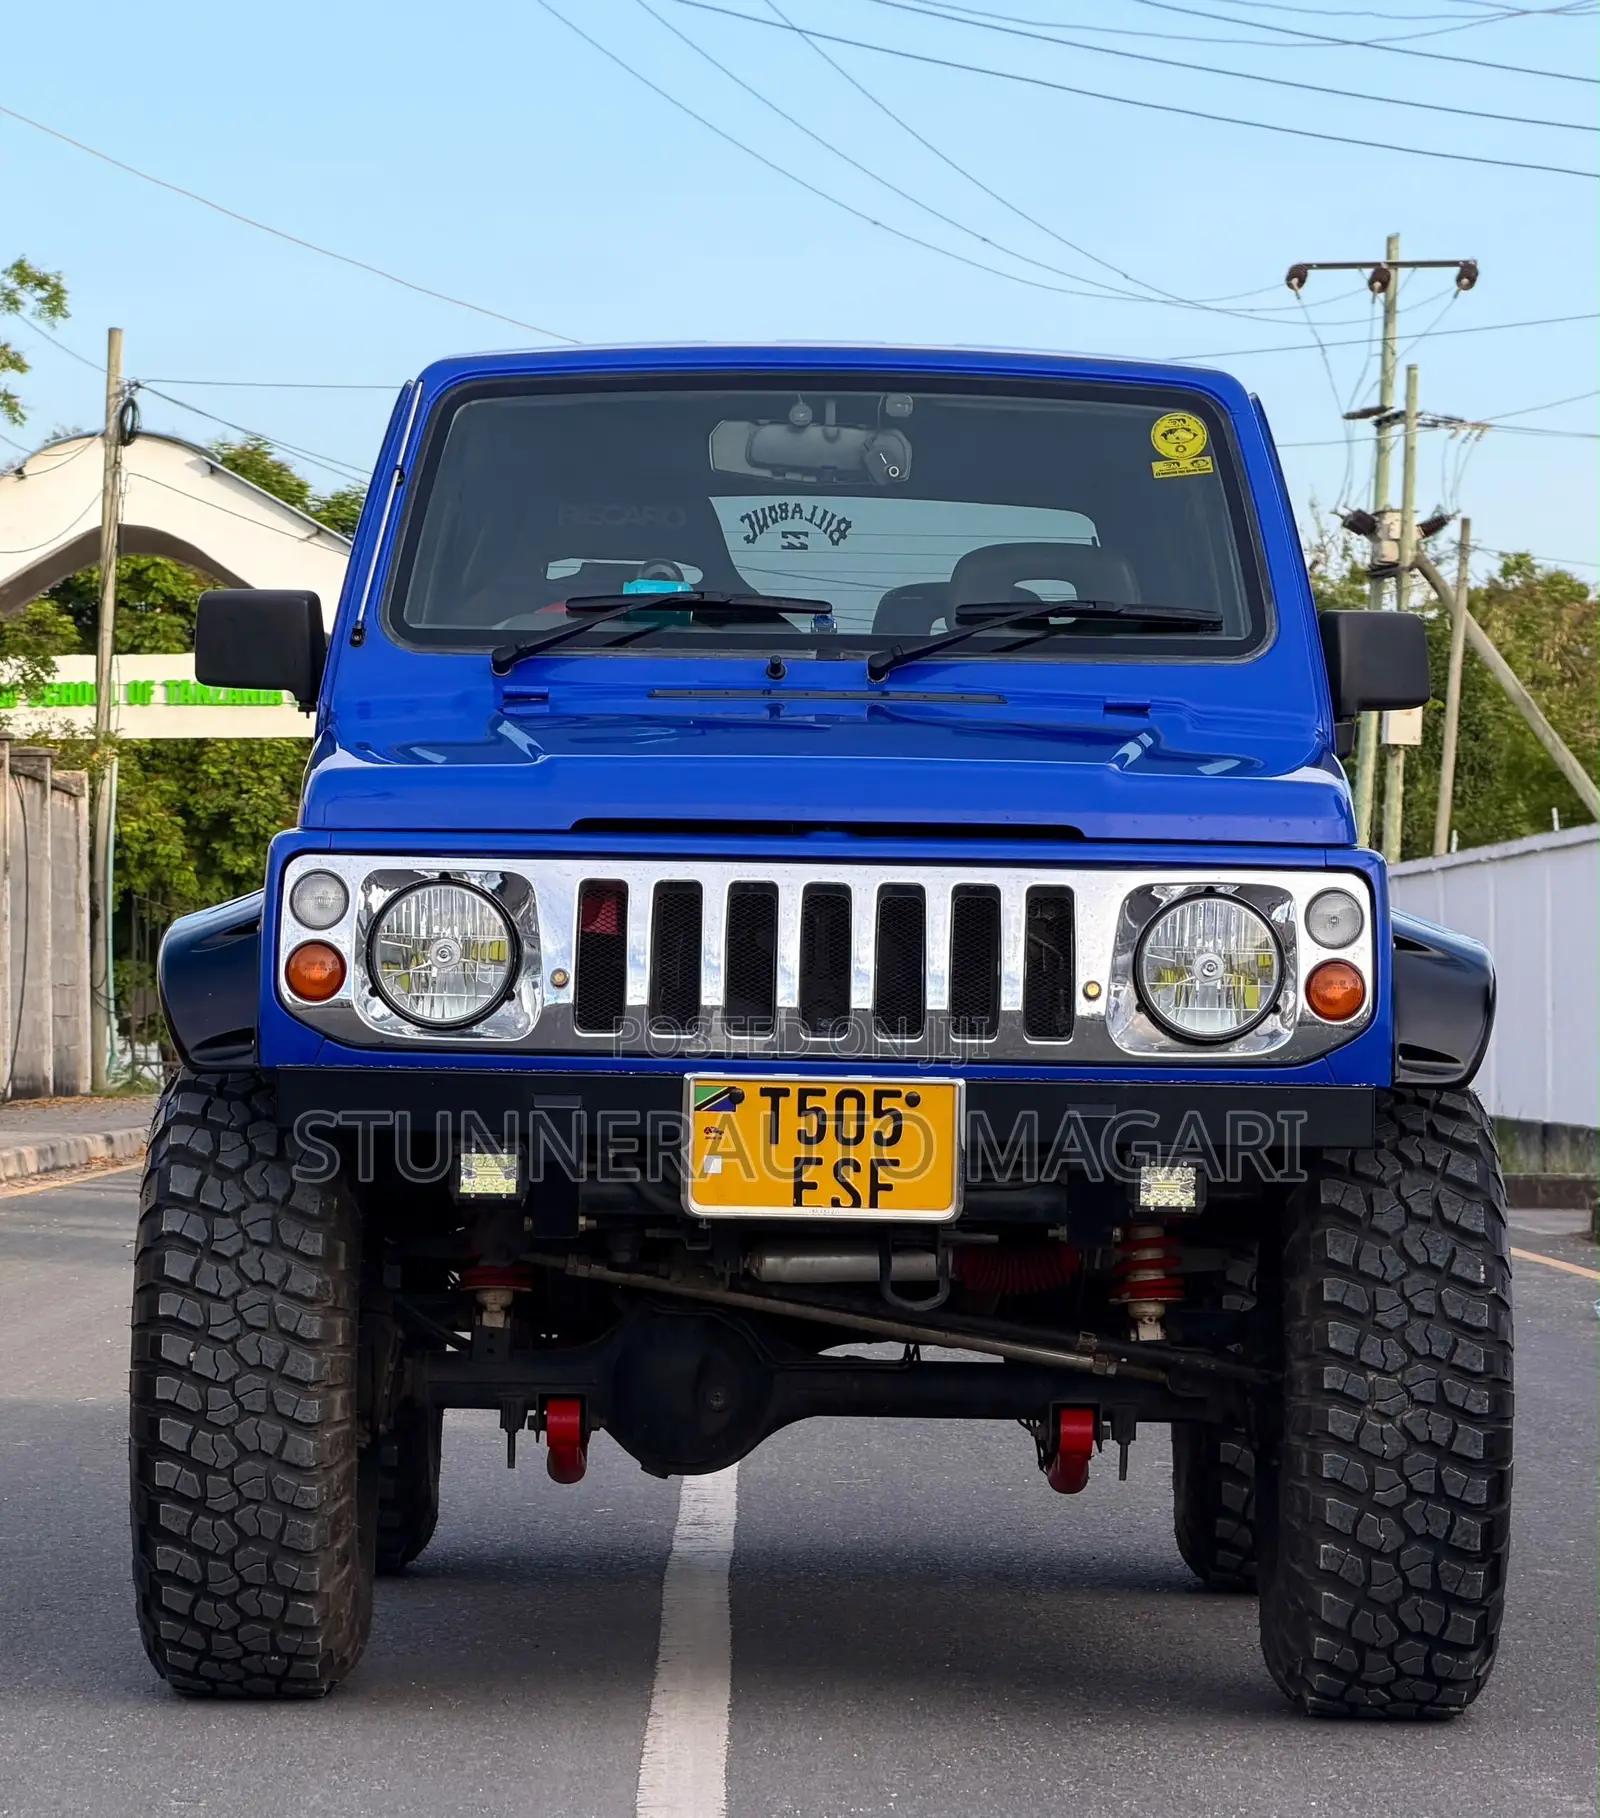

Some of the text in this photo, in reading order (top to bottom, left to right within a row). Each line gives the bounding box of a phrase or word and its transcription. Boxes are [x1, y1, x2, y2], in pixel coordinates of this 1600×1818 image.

[127, 679, 156, 706] OF
[759, 1086, 904, 1147] T505
[792, 1156, 901, 1209] ESF
